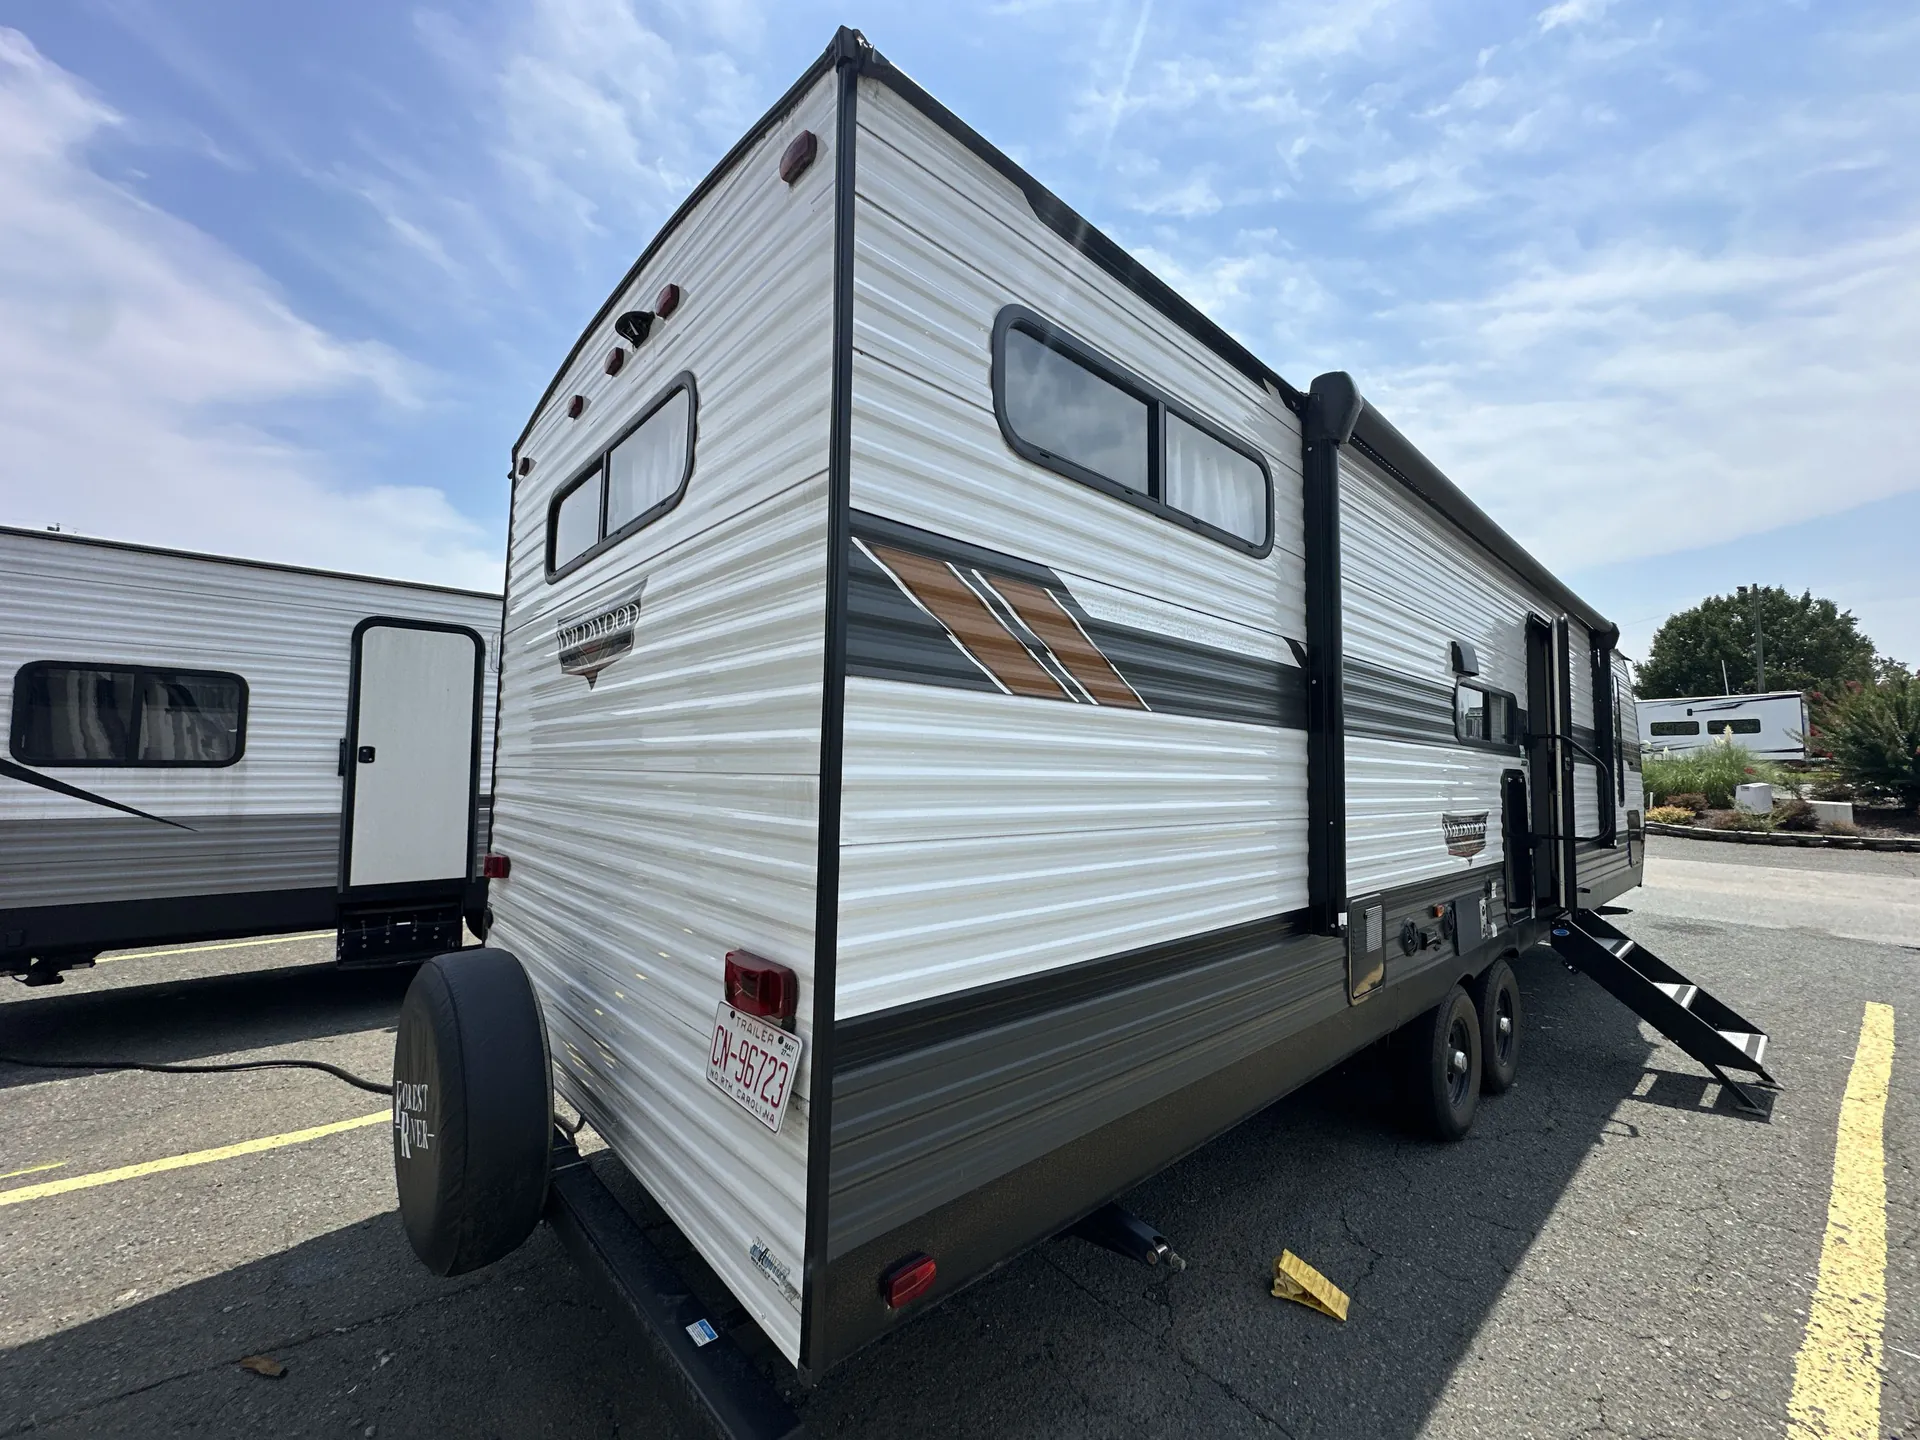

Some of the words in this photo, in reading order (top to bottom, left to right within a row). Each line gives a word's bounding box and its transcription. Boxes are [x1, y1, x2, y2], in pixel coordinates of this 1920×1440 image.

[736, 1016, 775, 1047] TRAILER
[711, 1025, 789, 1109] CN-96723
[395, 1080, 429, 1124] FOREST
[710, 1069, 733, 1091] NORTH
[736, 1088, 775, 1125] CAROLINA
